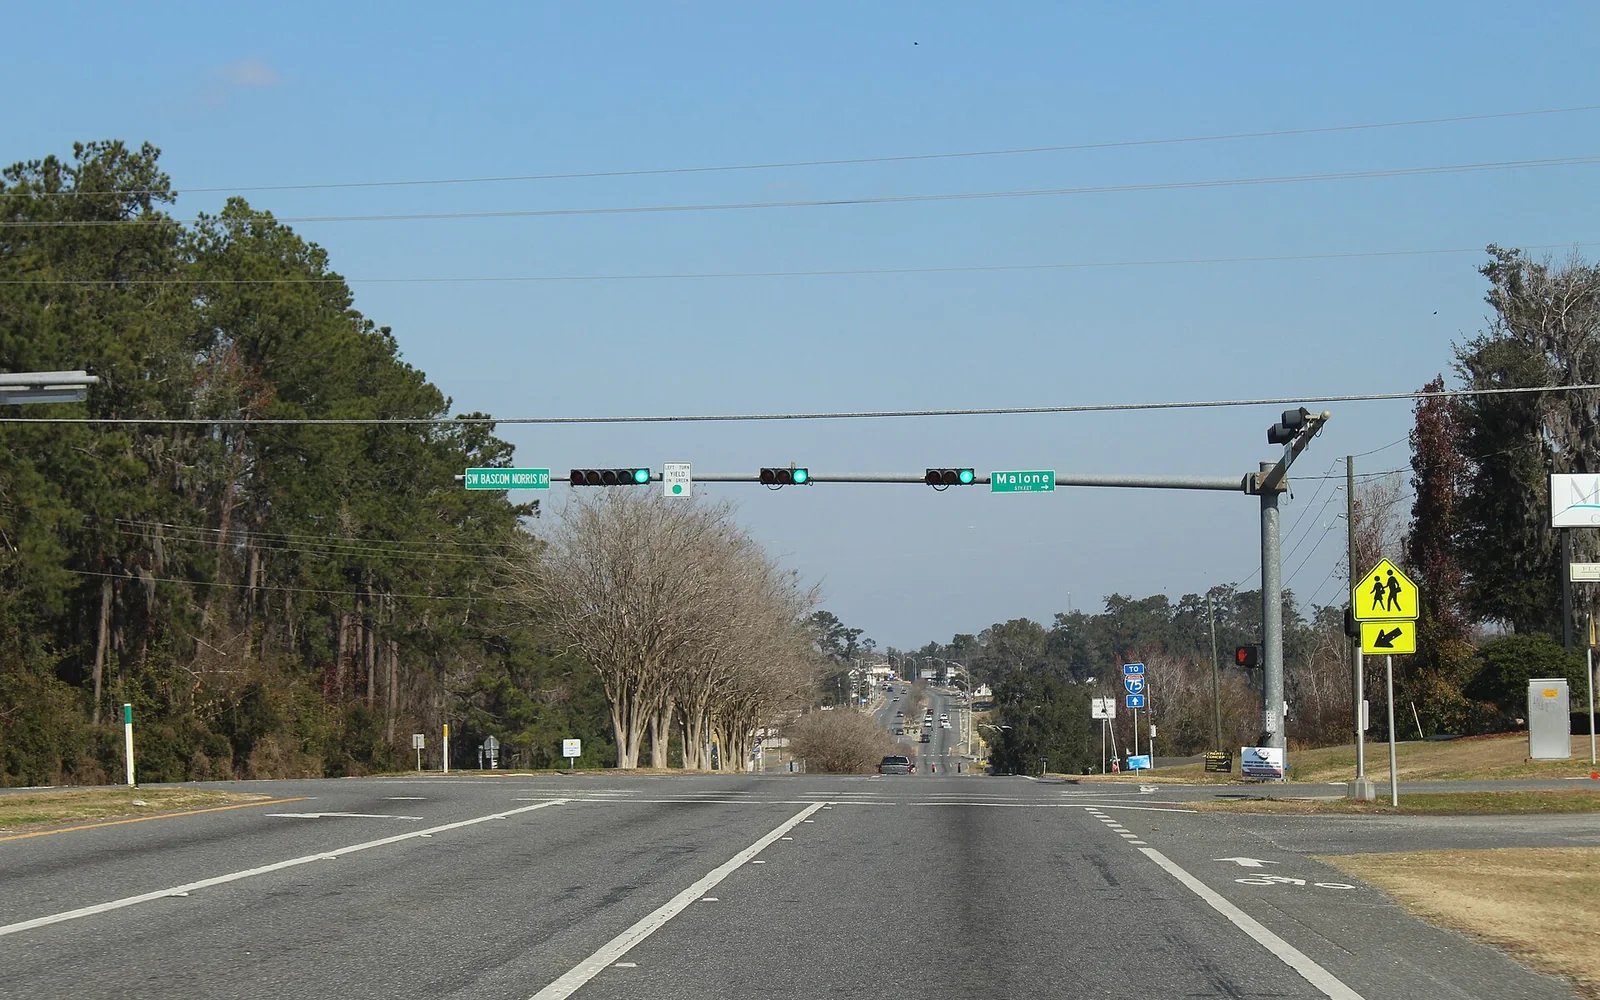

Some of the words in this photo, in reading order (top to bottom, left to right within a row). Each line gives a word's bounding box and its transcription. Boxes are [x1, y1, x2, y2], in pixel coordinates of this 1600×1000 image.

[467, 473, 479, 484] SW
[480, 473, 510, 484] BASCOM
[512, 473, 538, 484] NORRIS
[539, 473, 549, 484] DR
[996, 473, 1049, 484] Malone
[1127, 679, 1142, 691] 75
